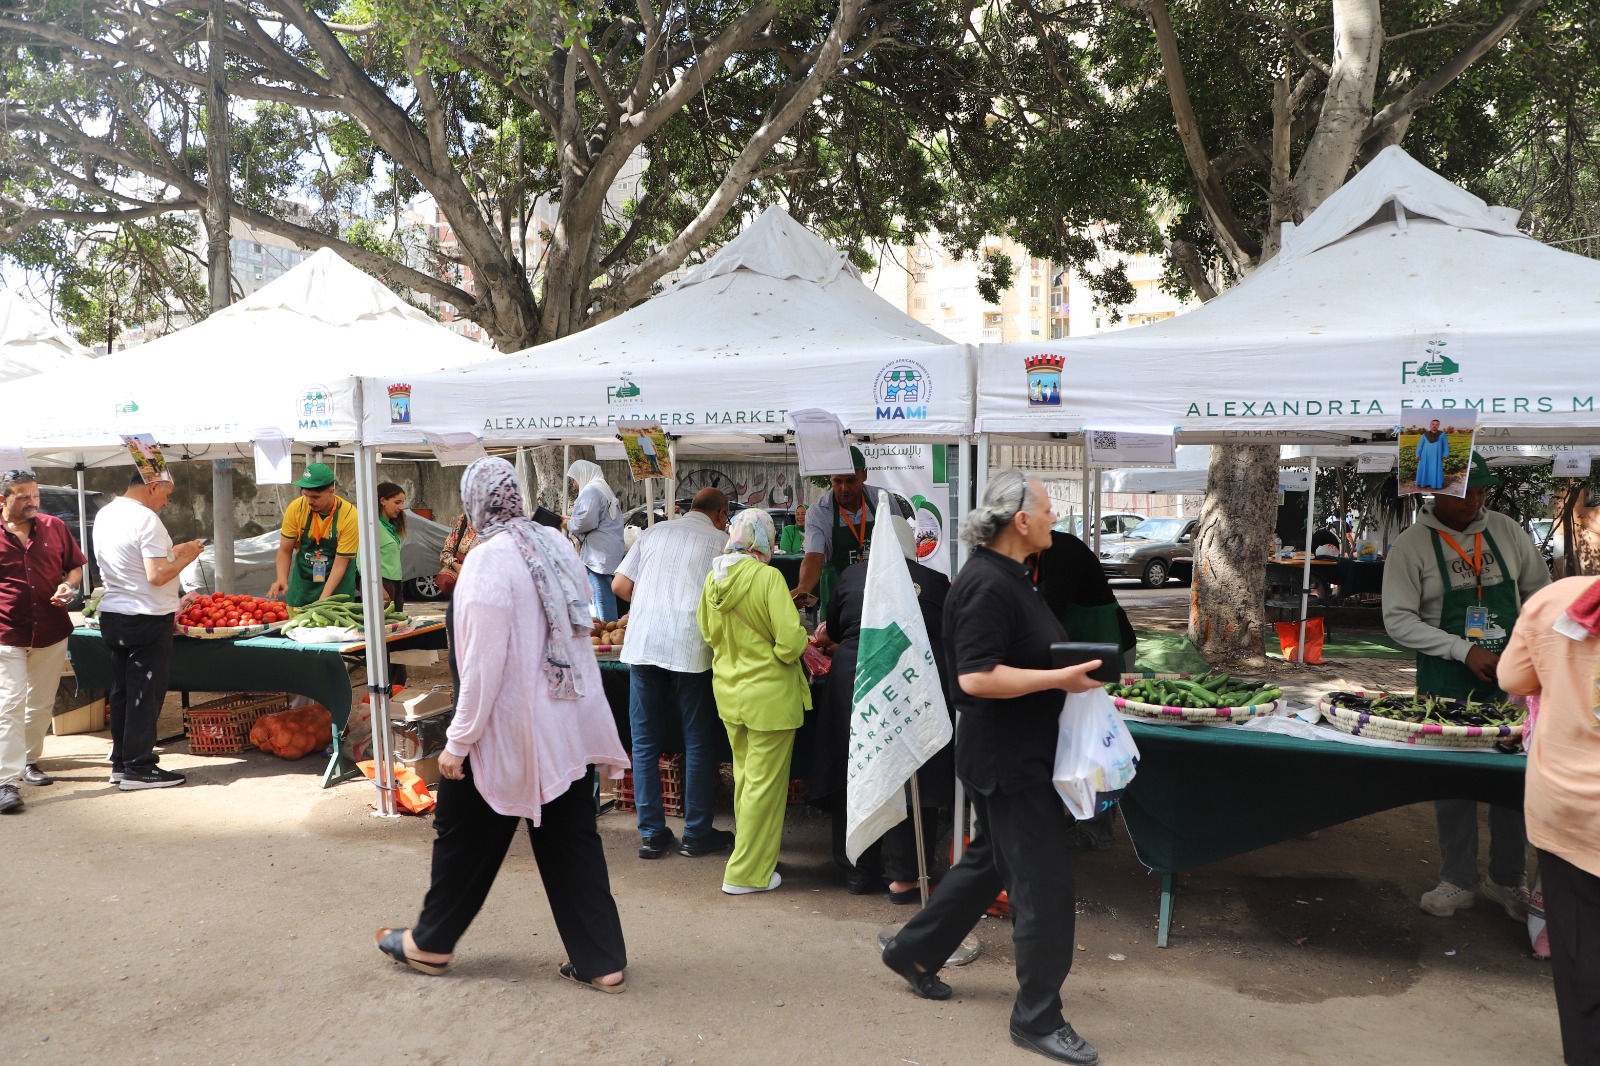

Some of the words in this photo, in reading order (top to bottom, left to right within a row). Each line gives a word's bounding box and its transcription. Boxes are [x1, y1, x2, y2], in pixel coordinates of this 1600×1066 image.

[1186, 399, 1384, 417] ALEXANDRIA
[484, 415, 599, 430] ALEXANDRIA
[705, 410, 789, 425] MARKET
[848, 701, 932, 783] LEXANDRIA
